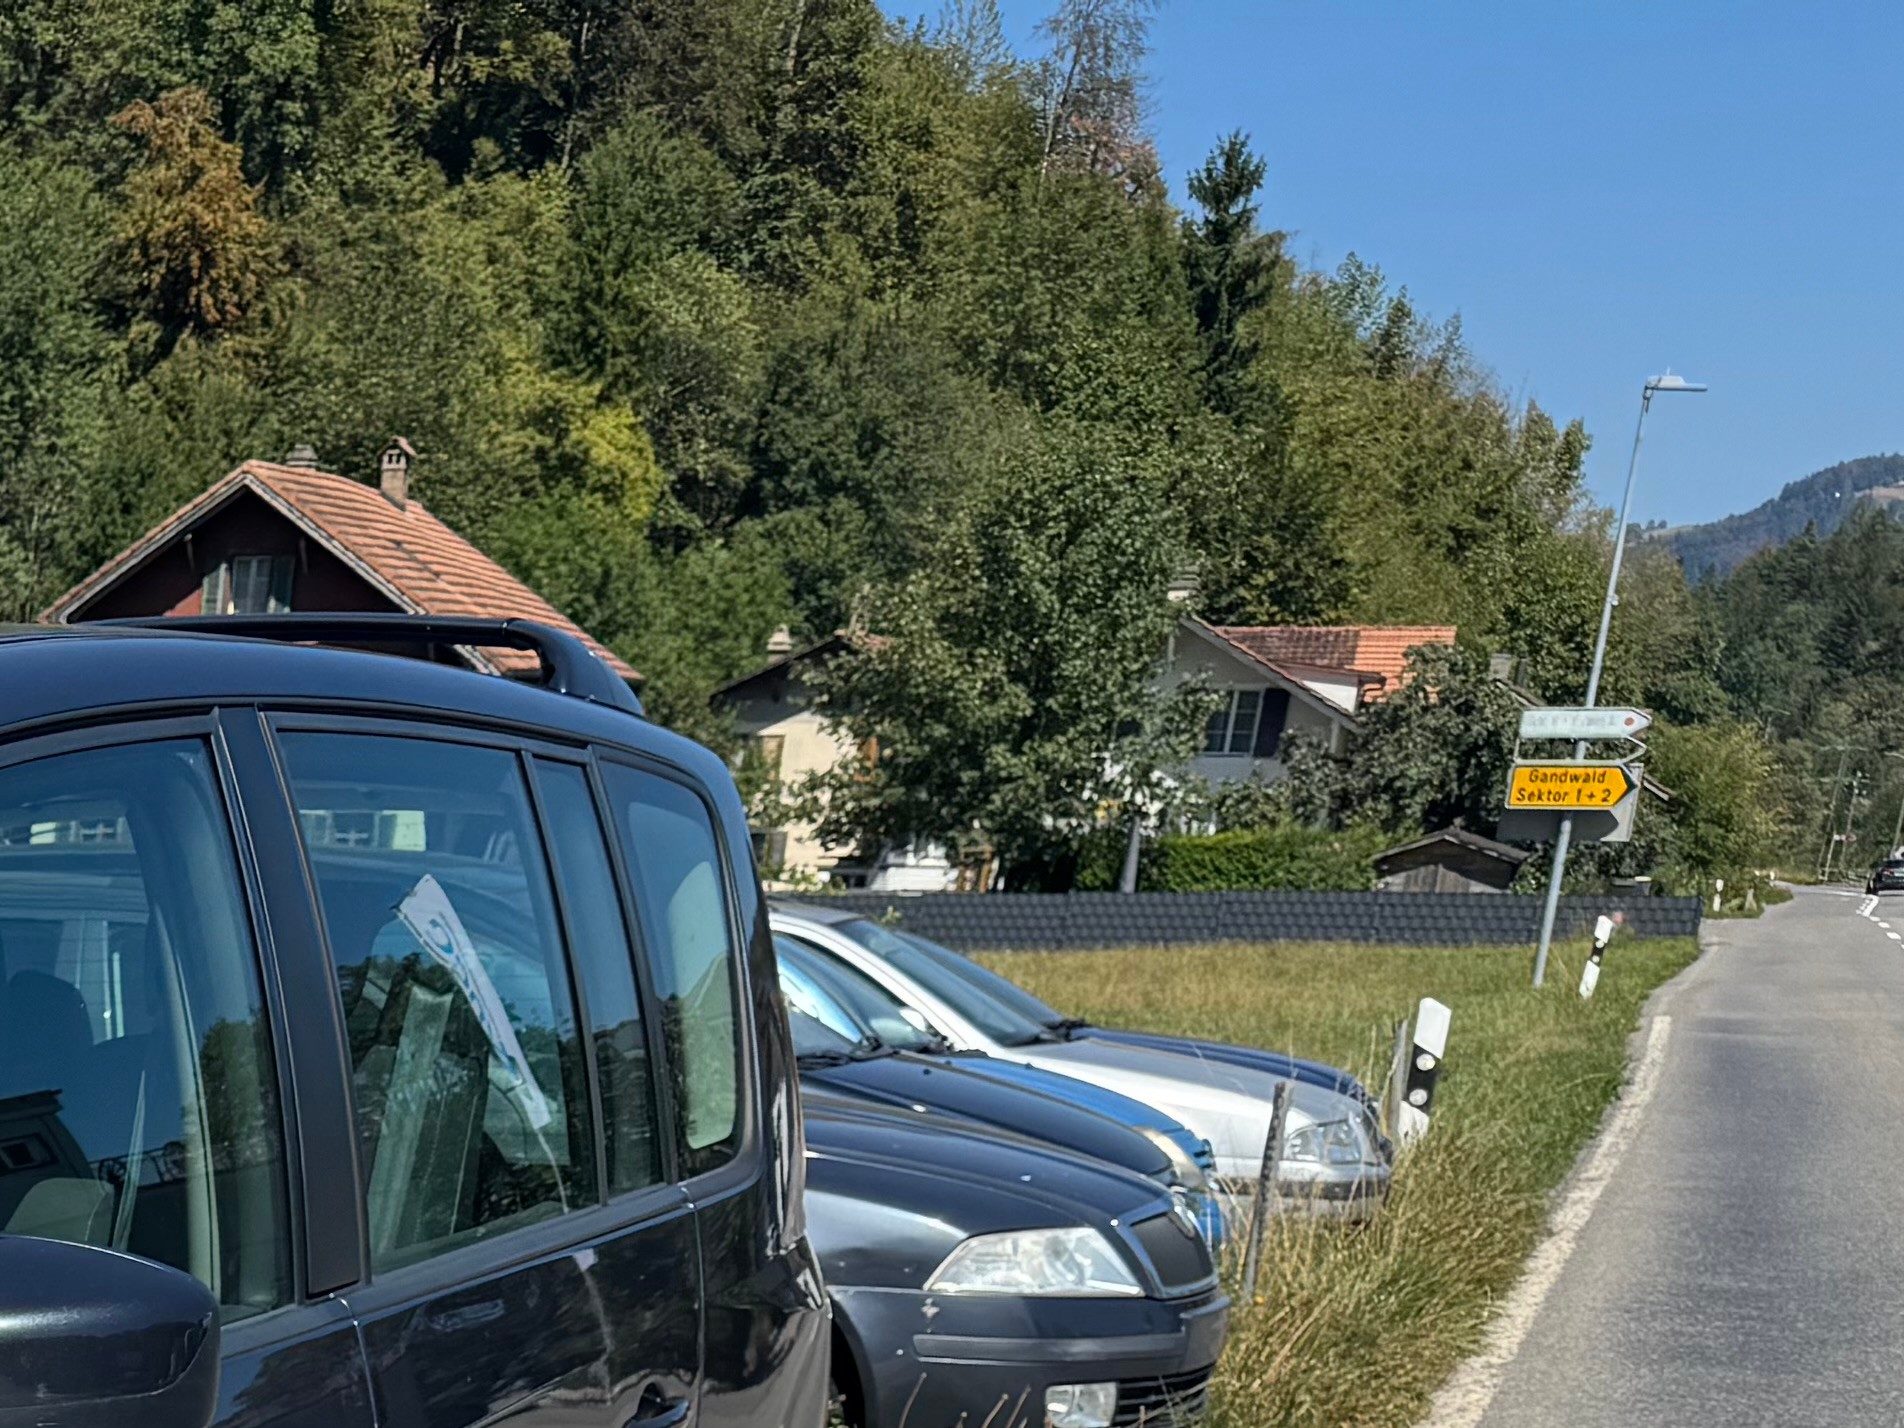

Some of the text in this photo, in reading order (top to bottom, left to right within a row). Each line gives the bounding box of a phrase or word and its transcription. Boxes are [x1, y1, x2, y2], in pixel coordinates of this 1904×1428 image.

[1529, 768, 1607, 784] Gandwald
[1516, 787, 1569, 803] Sektor
[1601, 788, 1612, 803] 2
